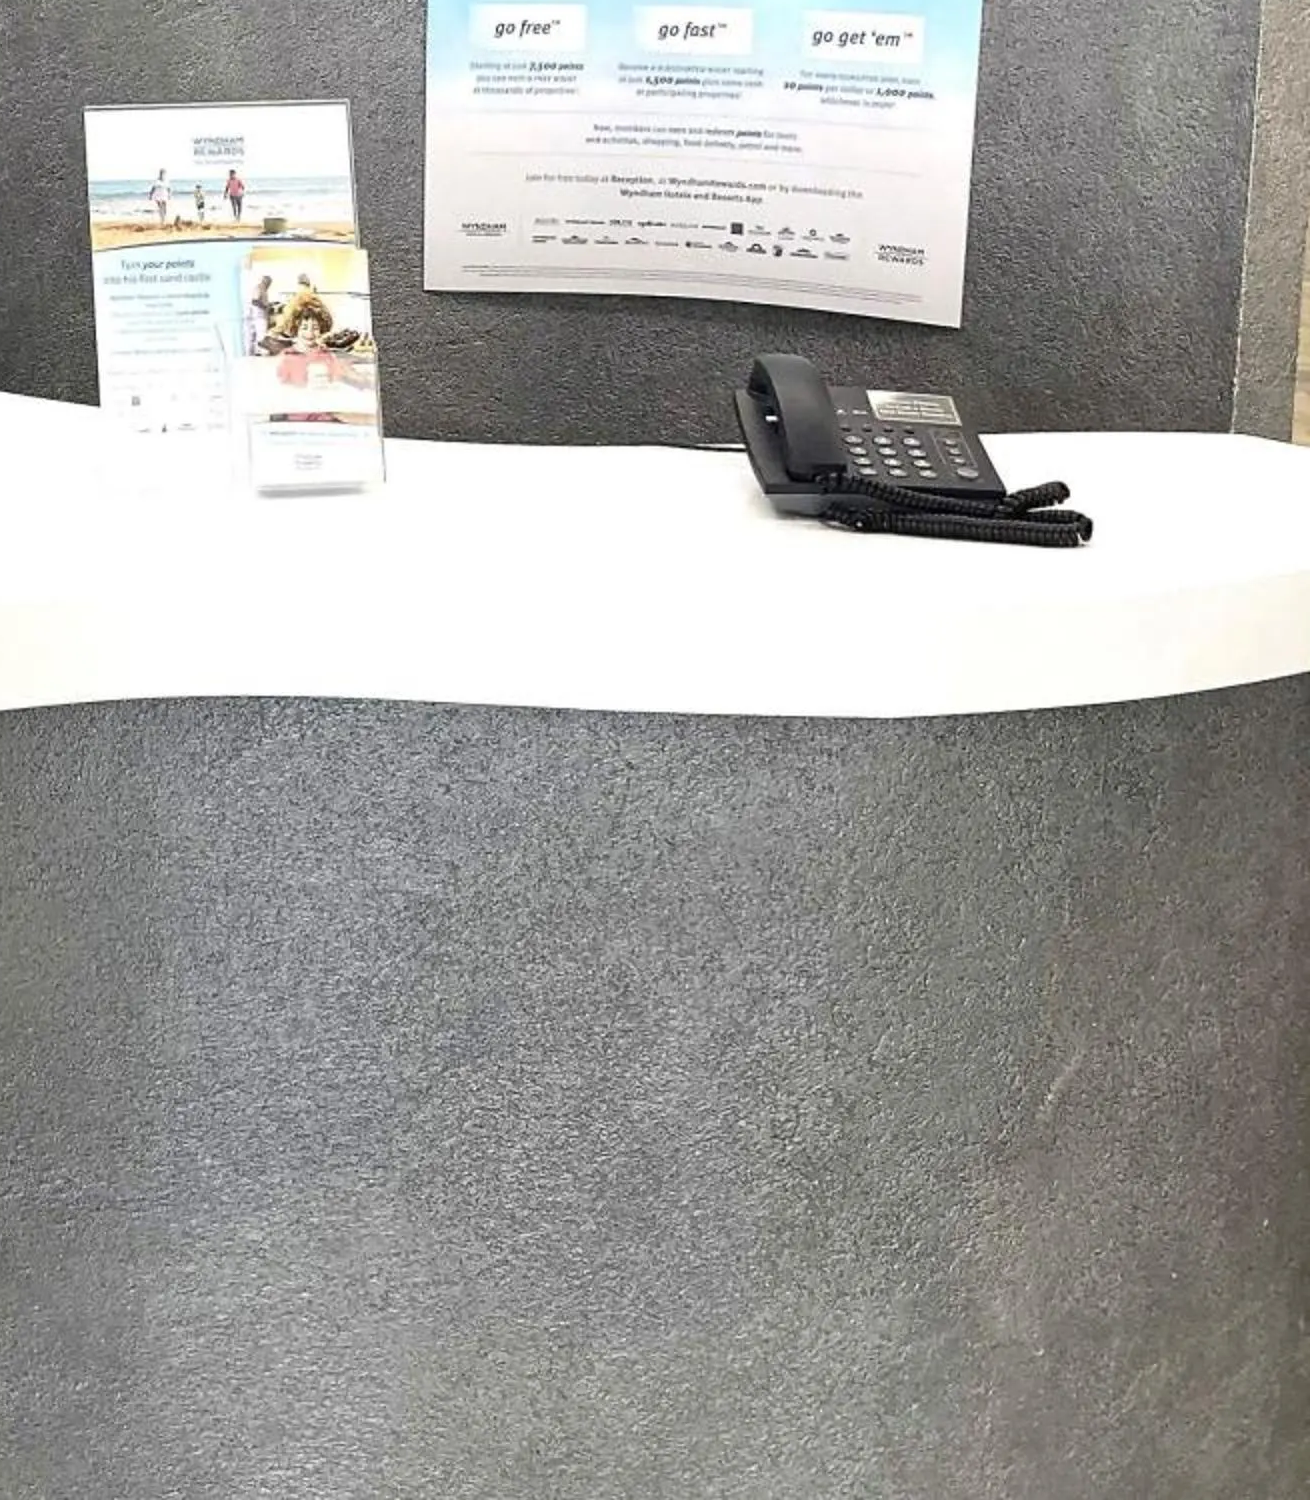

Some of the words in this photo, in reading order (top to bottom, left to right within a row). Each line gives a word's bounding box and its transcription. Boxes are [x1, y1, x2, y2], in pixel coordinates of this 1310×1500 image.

[494, 21, 515, 38] go
[658, 23, 679, 40] go
[812, 31, 834, 47] go
[838, 31, 866, 47] get
